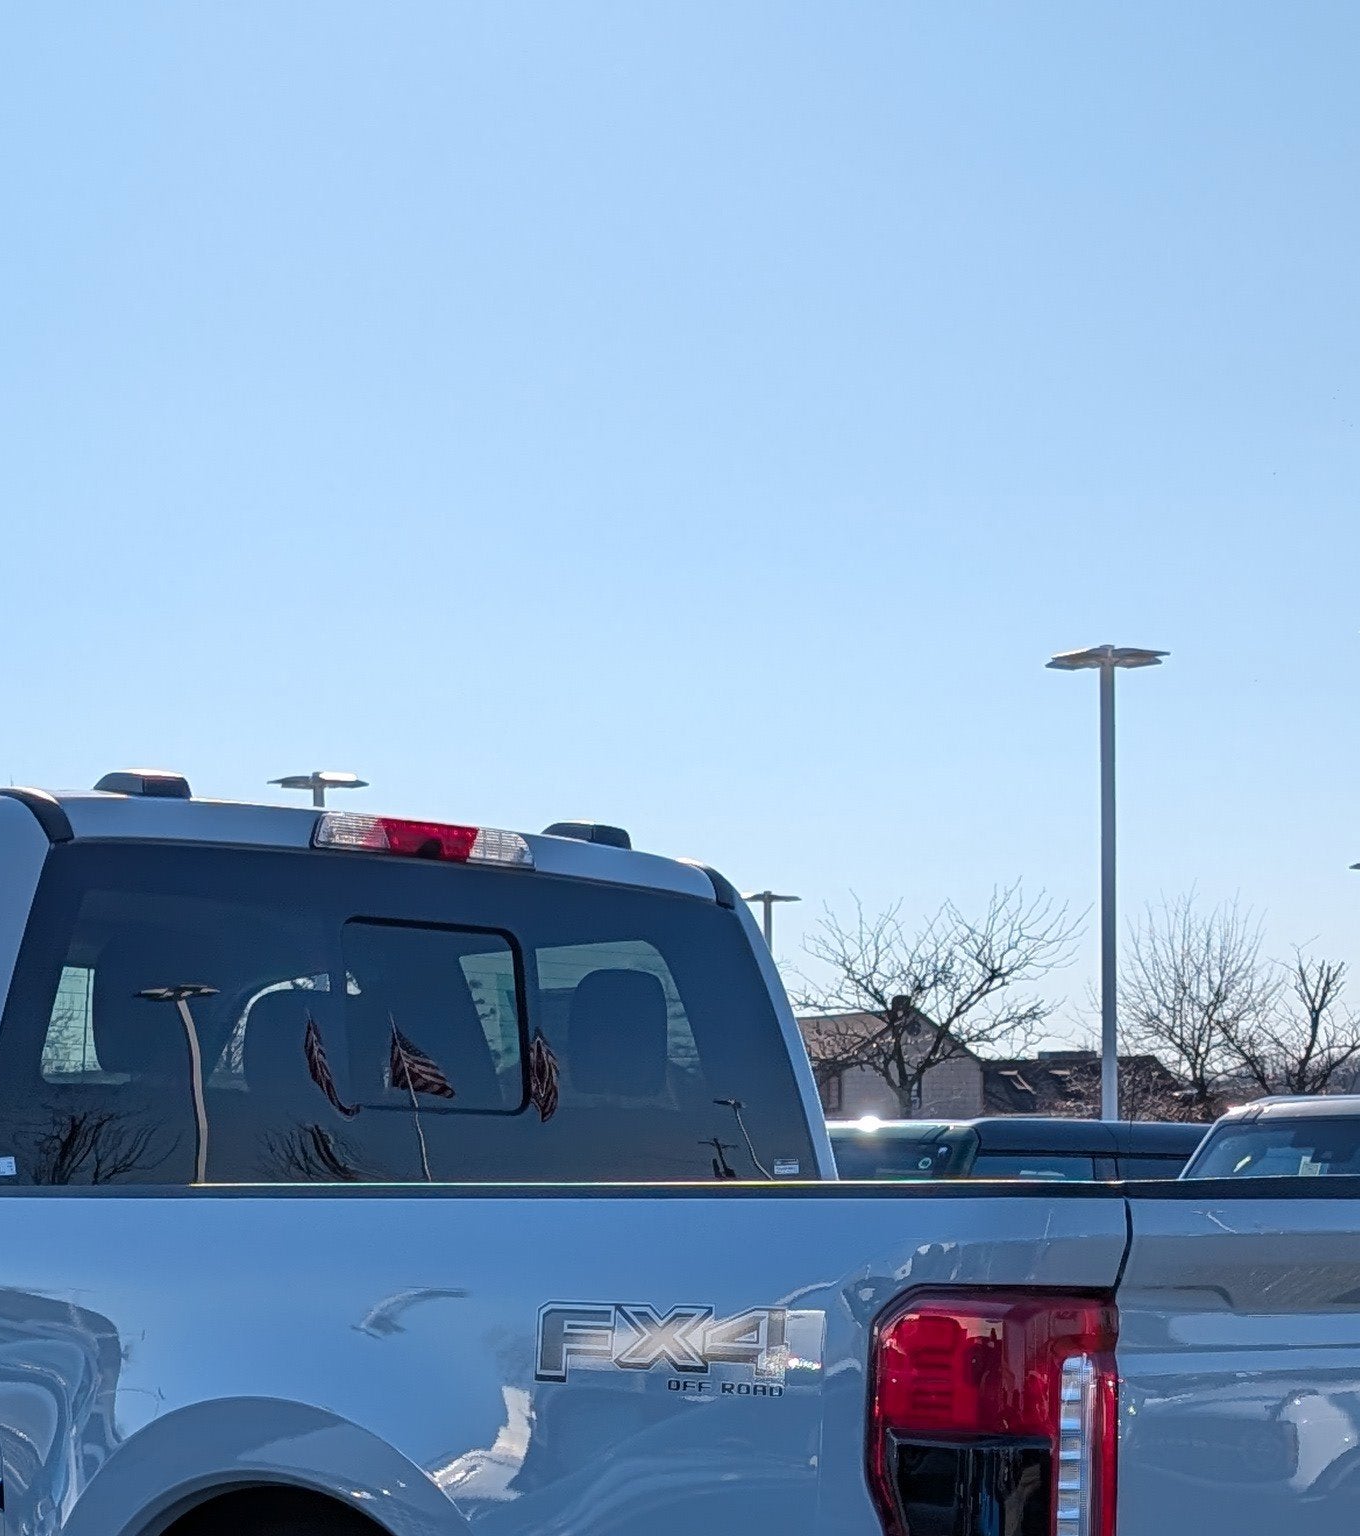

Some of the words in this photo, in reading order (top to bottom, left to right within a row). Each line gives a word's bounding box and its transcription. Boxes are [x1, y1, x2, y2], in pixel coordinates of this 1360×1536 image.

[534, 1299, 789, 1384] FX4
[667, 1379, 712, 1393] OFF
[721, 1382, 784, 1398] ROAD
